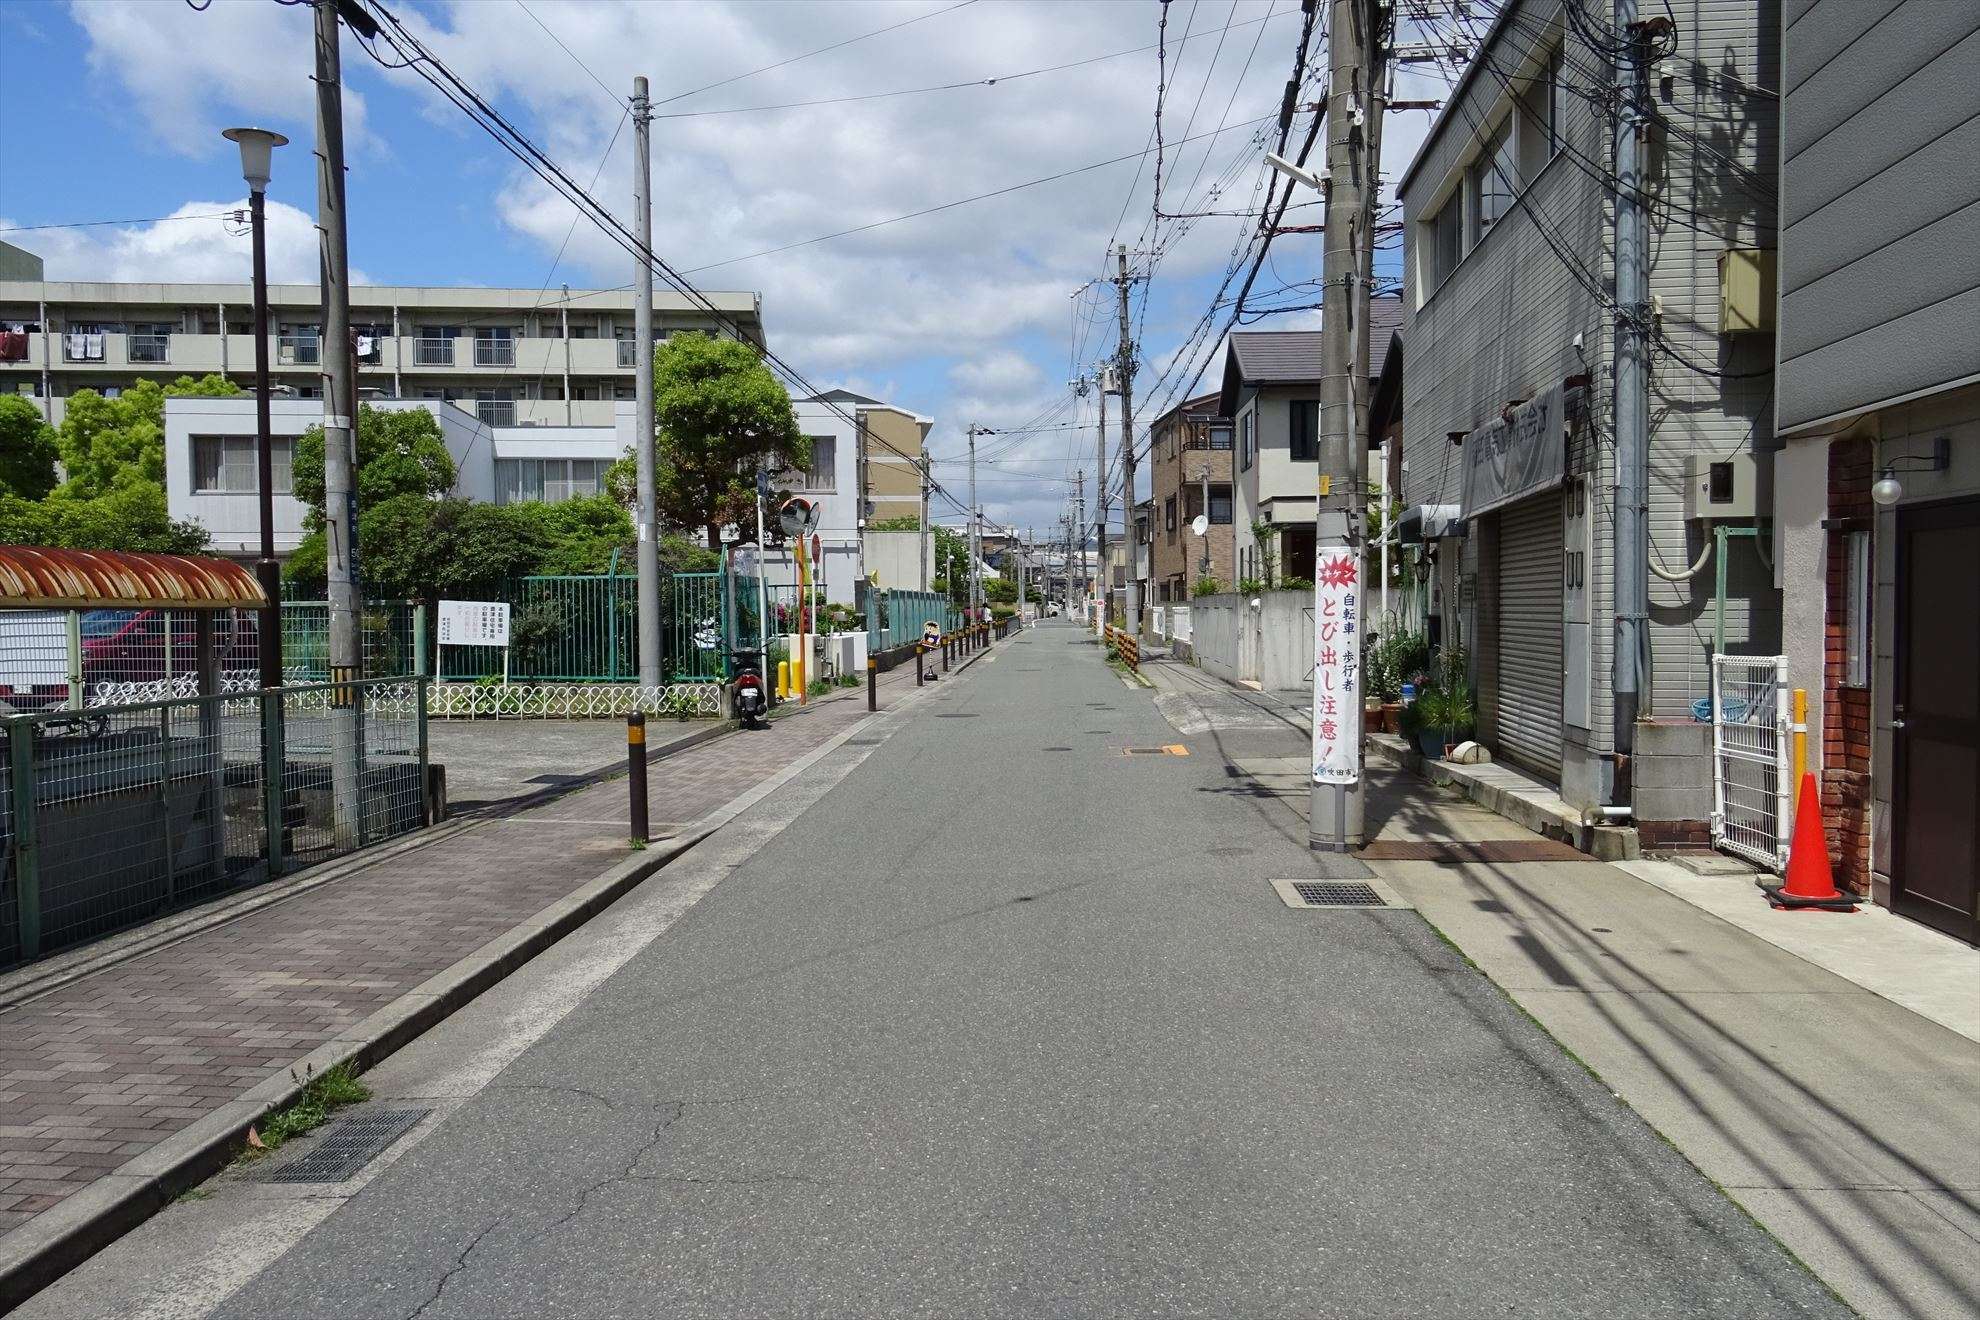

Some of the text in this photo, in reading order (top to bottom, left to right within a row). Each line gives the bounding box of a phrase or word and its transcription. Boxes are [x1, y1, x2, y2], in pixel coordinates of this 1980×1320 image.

[1323, 568, 1353, 579] キケン
[1342, 593, 1355, 692] 自転車・歩行者
[1320, 598, 1338, 761] とび出し注意!
[1327, 767, 1352, 777] 吹田市
